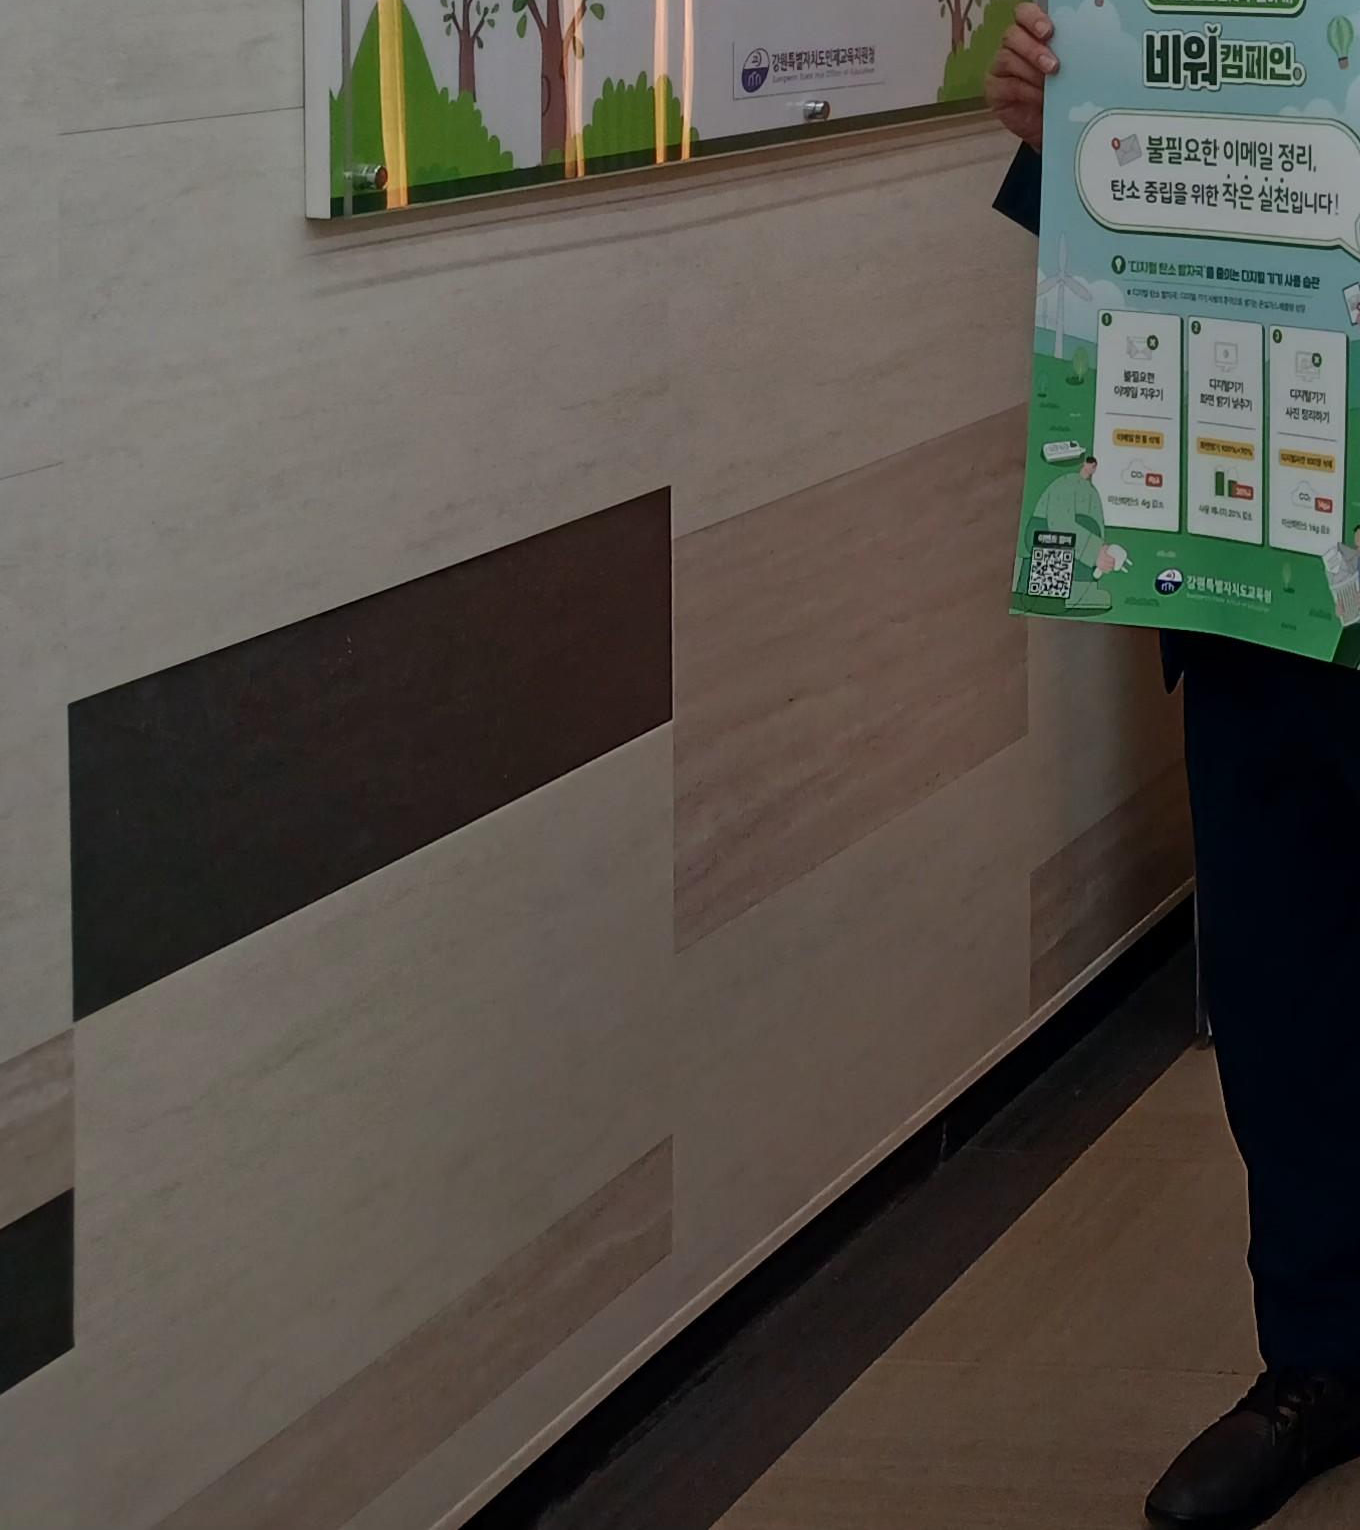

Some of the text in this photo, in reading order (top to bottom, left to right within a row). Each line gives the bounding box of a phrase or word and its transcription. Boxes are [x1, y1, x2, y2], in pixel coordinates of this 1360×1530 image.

[1146, 135, 1317, 173] 불필요한 이메일 정리,
[1111, 179, 1339, 215] 탄소 중립을 위한 작은 실천입니다!
